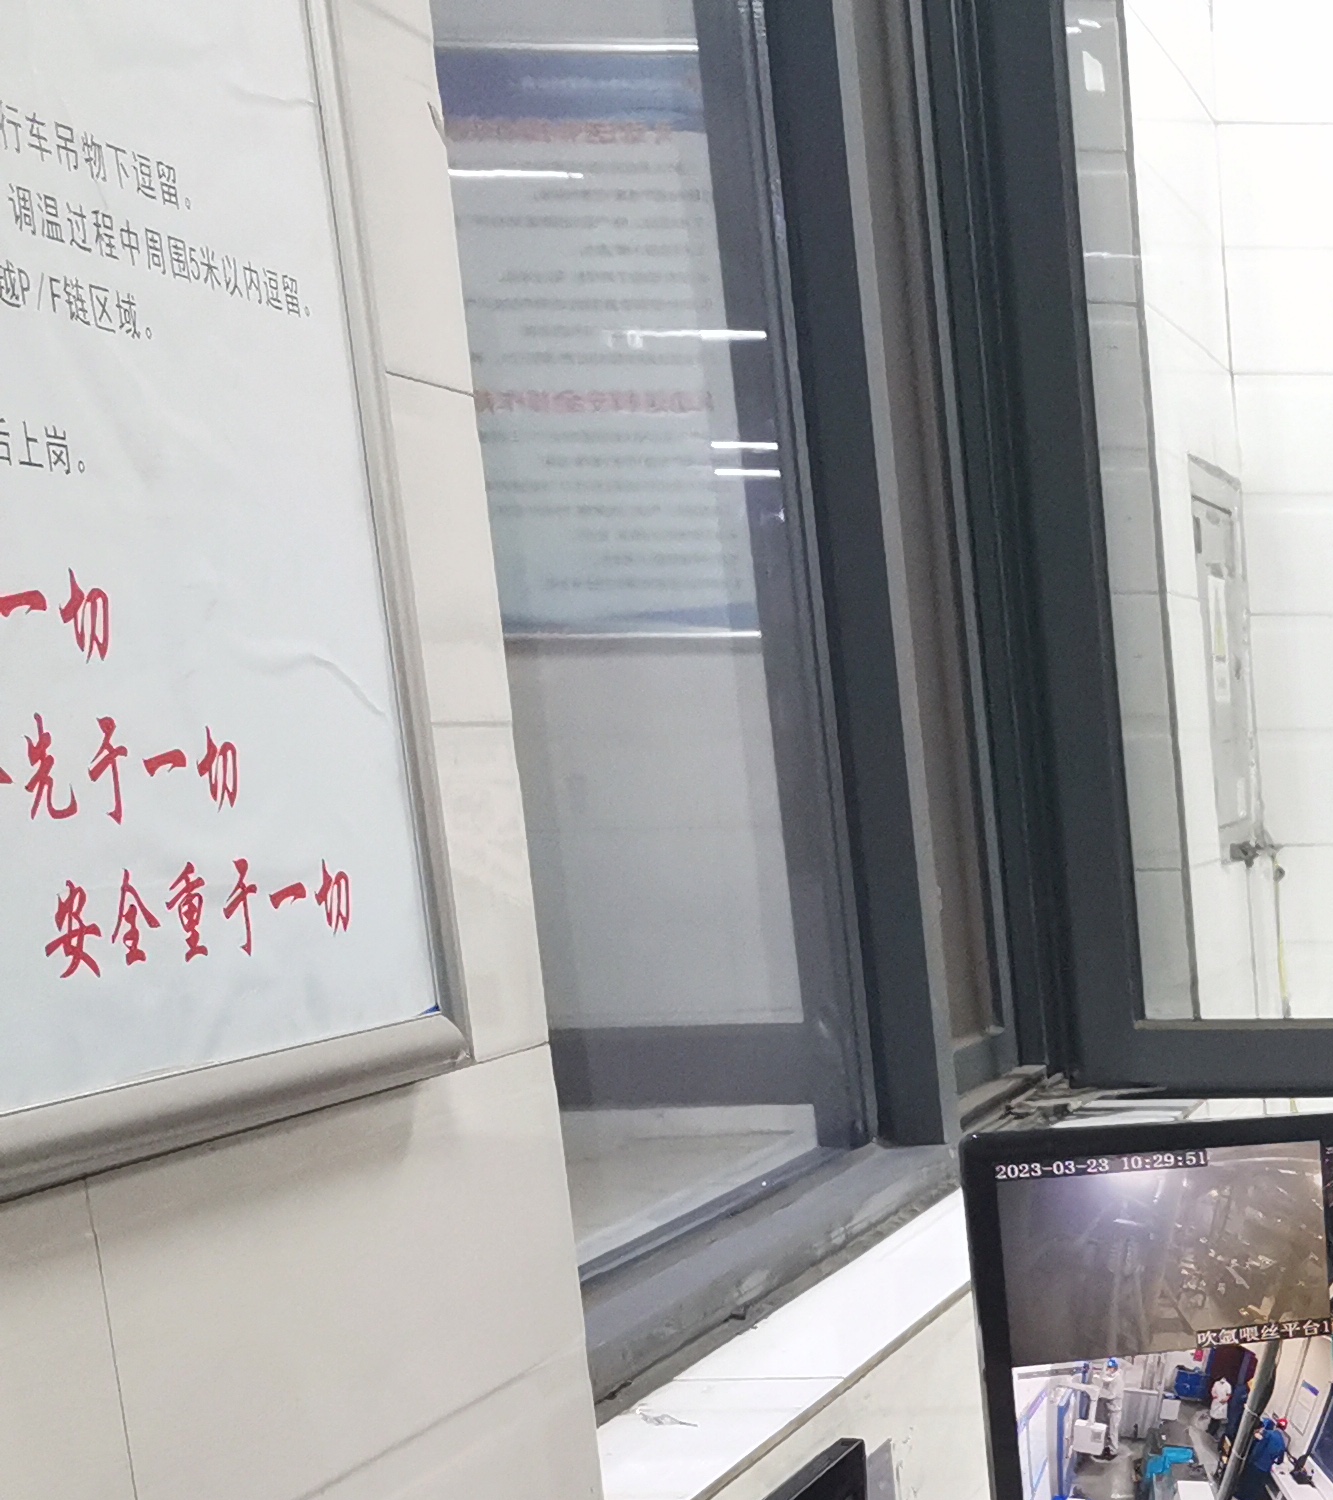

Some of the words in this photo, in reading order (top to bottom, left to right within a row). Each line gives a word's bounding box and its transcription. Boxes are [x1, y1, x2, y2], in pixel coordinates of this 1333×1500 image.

[8, 182, 311, 318] 调温过程中周围5米以内逗留。
[0, 711, 240, 825] 先于一切
[44, 857, 351, 979] 安全重于一切
[995, 1158, 1109, 1180] 2023-03-23
[1121, 1151, 1206, 1171] 10:29:51
[1197, 1319, 1330, 1346] 吹氩喂丝平台1
